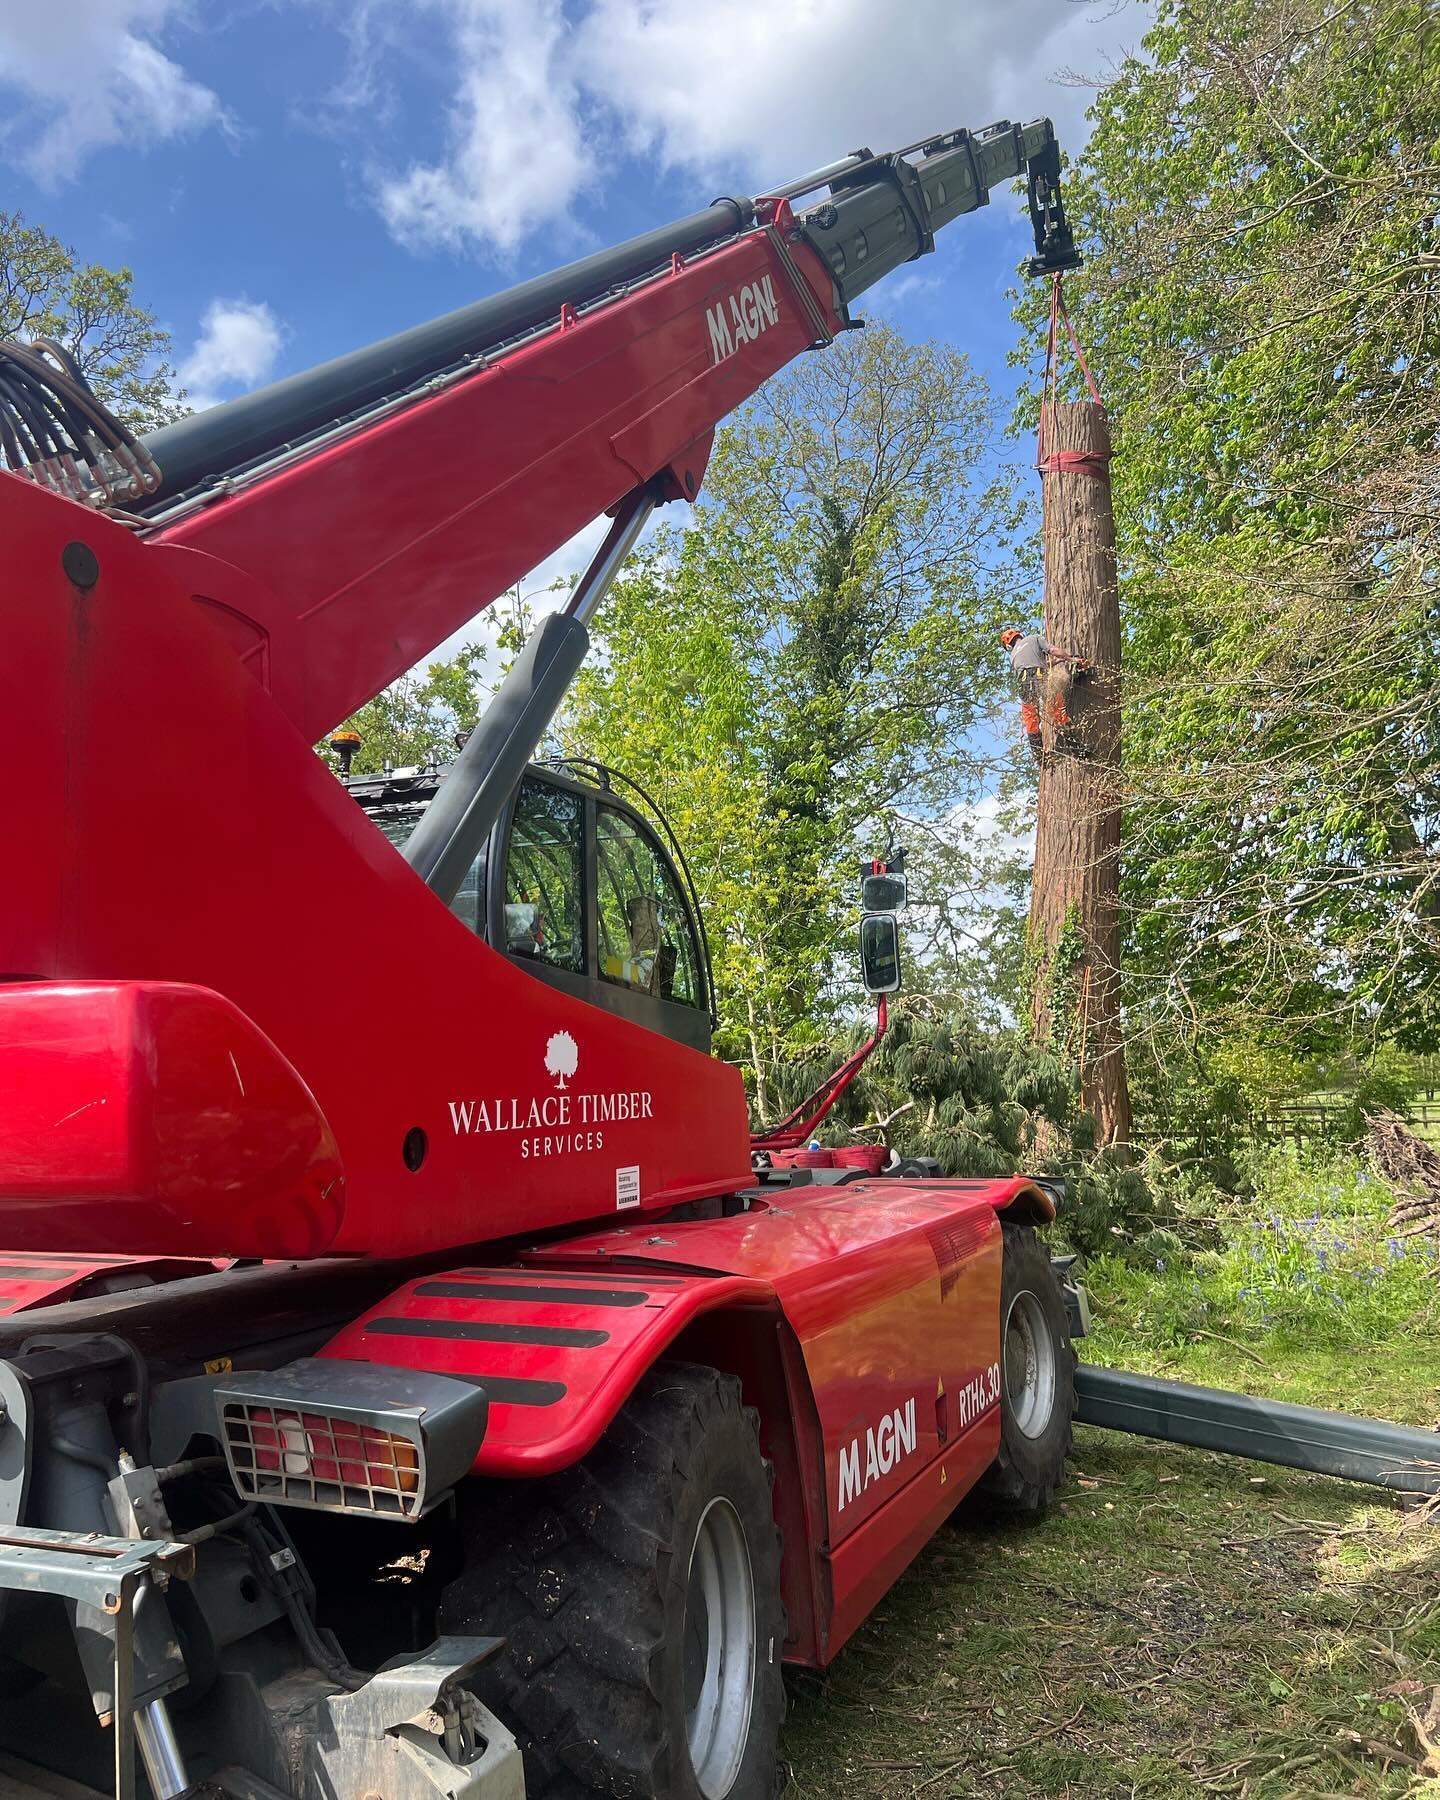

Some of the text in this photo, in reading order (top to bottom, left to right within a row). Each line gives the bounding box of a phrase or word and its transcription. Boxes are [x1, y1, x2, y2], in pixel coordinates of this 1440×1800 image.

[706, 274, 779, 365] MAGNI
[448, 1092, 653, 1135] WALLACE TIMBER
[521, 1132, 603, 1158] SERVICES
[959, 1362, 1001, 1427] RTH6.30
[838, 1397, 917, 1512] MAGNI
